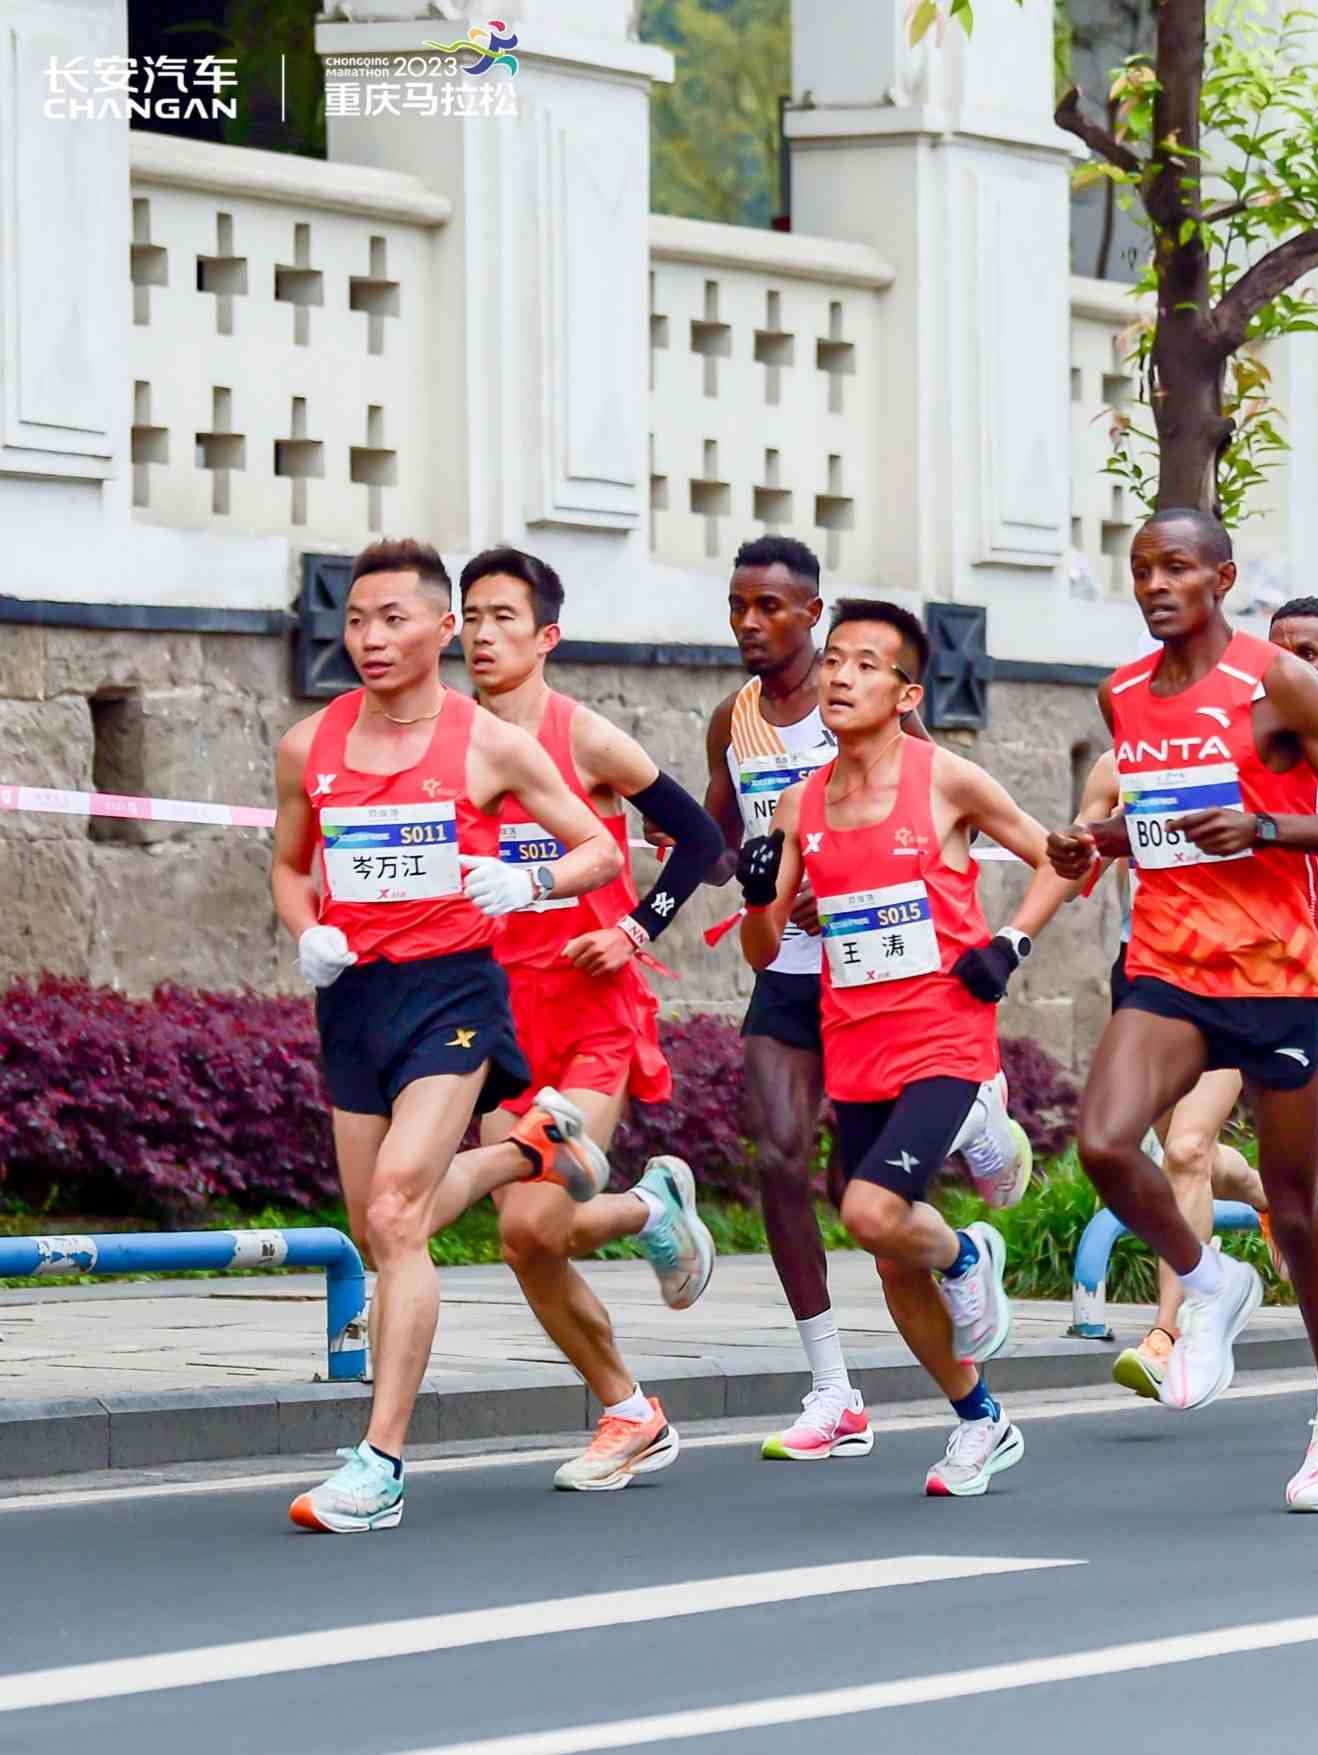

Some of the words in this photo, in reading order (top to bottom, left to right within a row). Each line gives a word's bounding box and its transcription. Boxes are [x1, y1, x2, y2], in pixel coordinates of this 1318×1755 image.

[1117, 735, 1232, 763] ANTA
[400, 824, 448, 845] S011
[1136, 819, 1181, 847] BOS
[518, 842, 560, 860] S012
[352, 855, 427, 880] 岑万江
[877, 903, 921, 926] S015
[842, 941, 862, 965] 王
[881, 934, 905, 958] 涛
